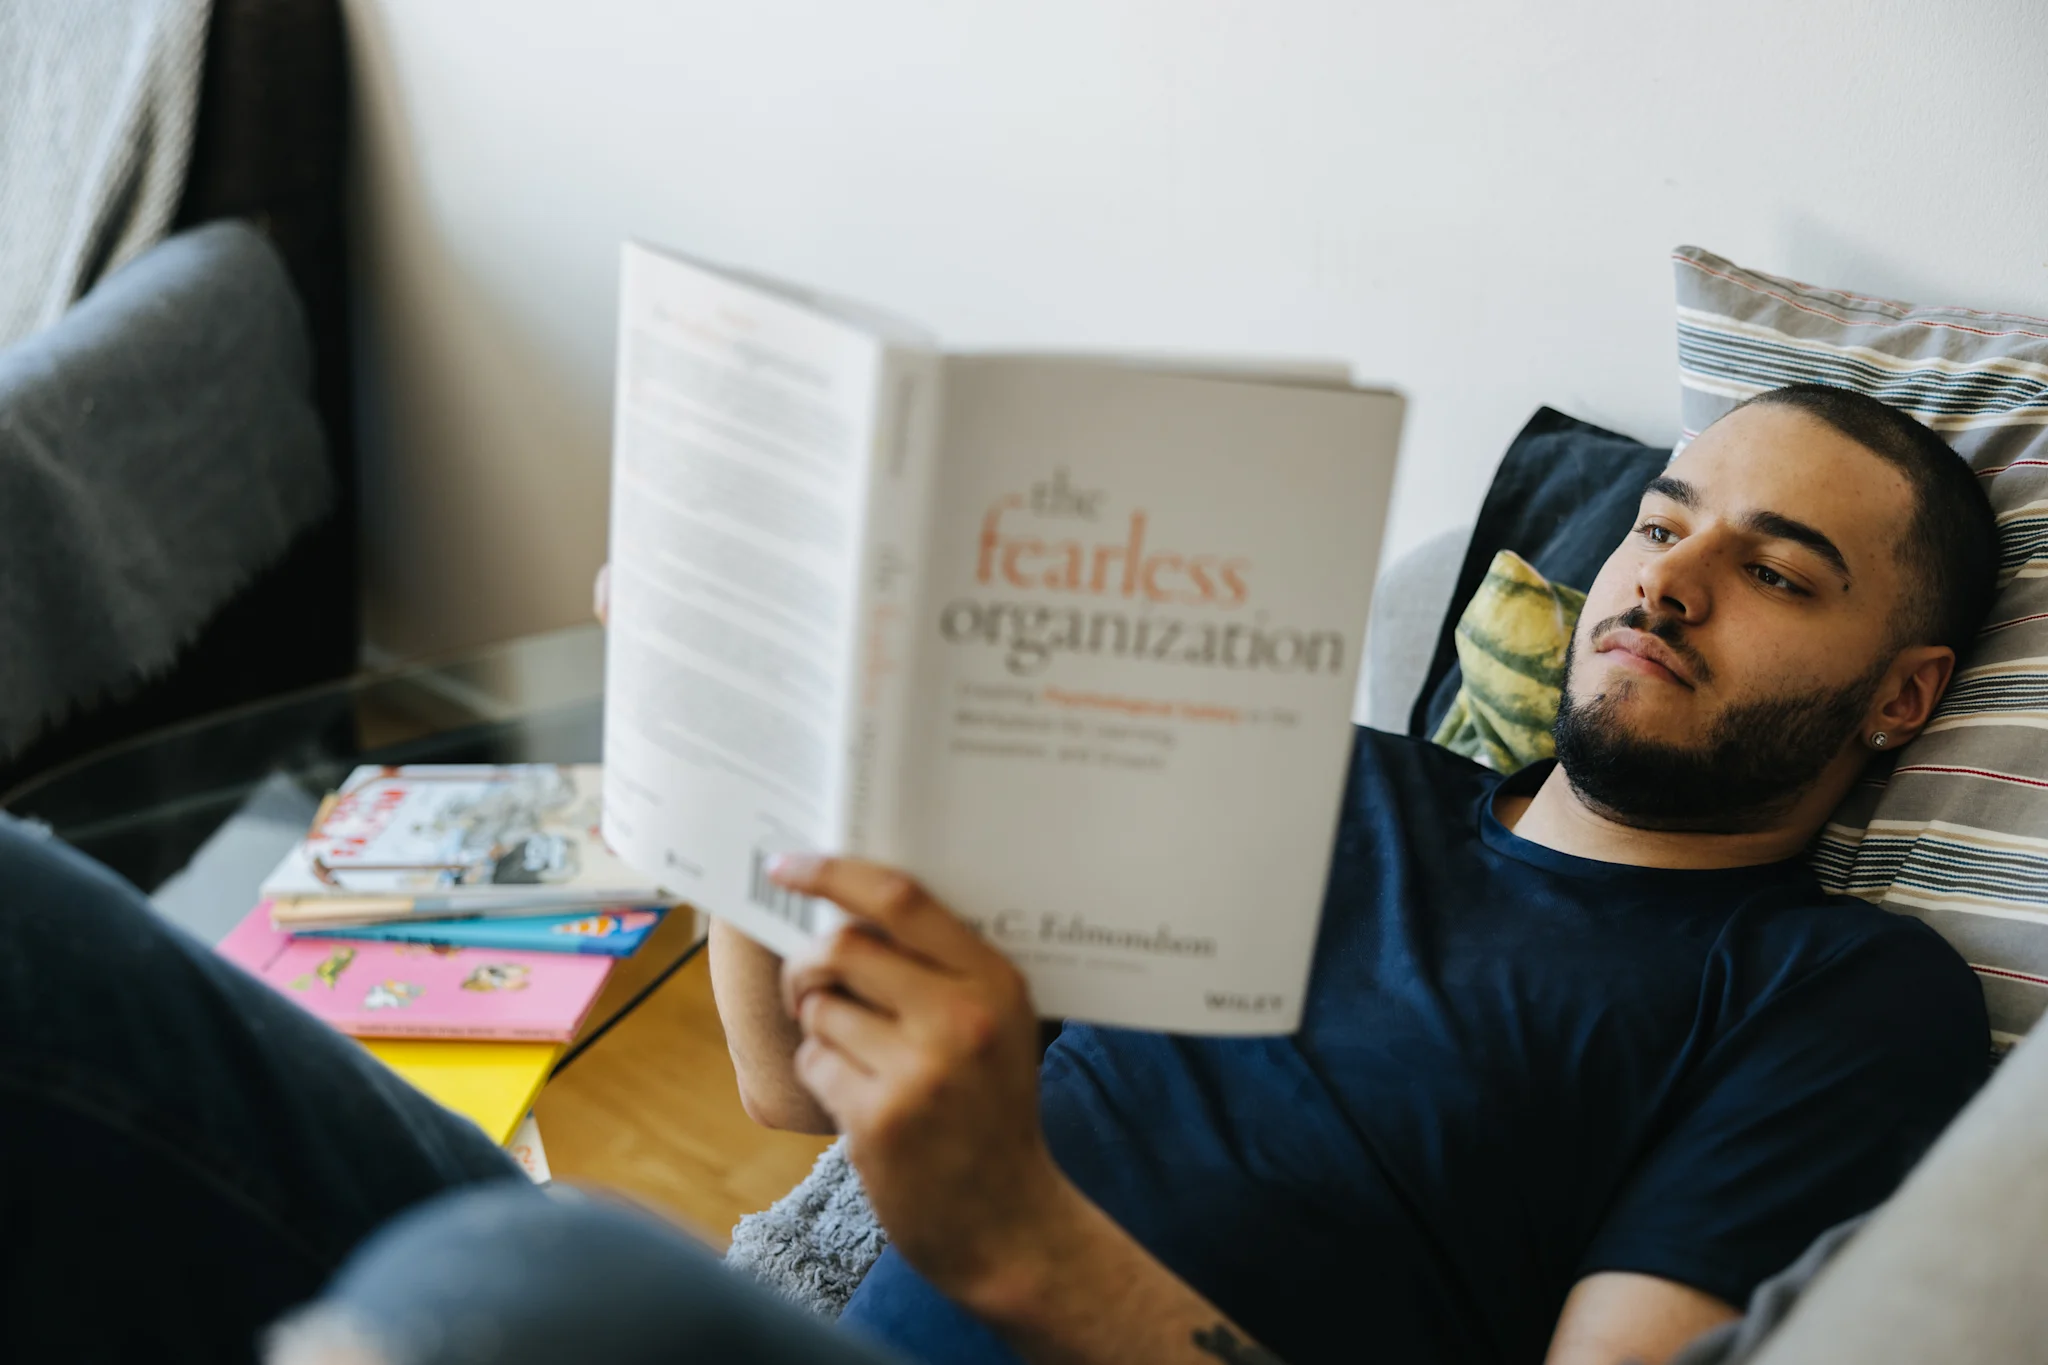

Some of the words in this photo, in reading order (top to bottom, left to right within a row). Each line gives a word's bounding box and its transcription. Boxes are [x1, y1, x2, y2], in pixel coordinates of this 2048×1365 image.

[1030, 465, 1104, 520] the
[974, 494, 1251, 609] fearless
[939, 599, 1345, 677] organization
[1038, 909, 1217, 957] Edmondson
[1203, 991, 1286, 1013] WILEY
